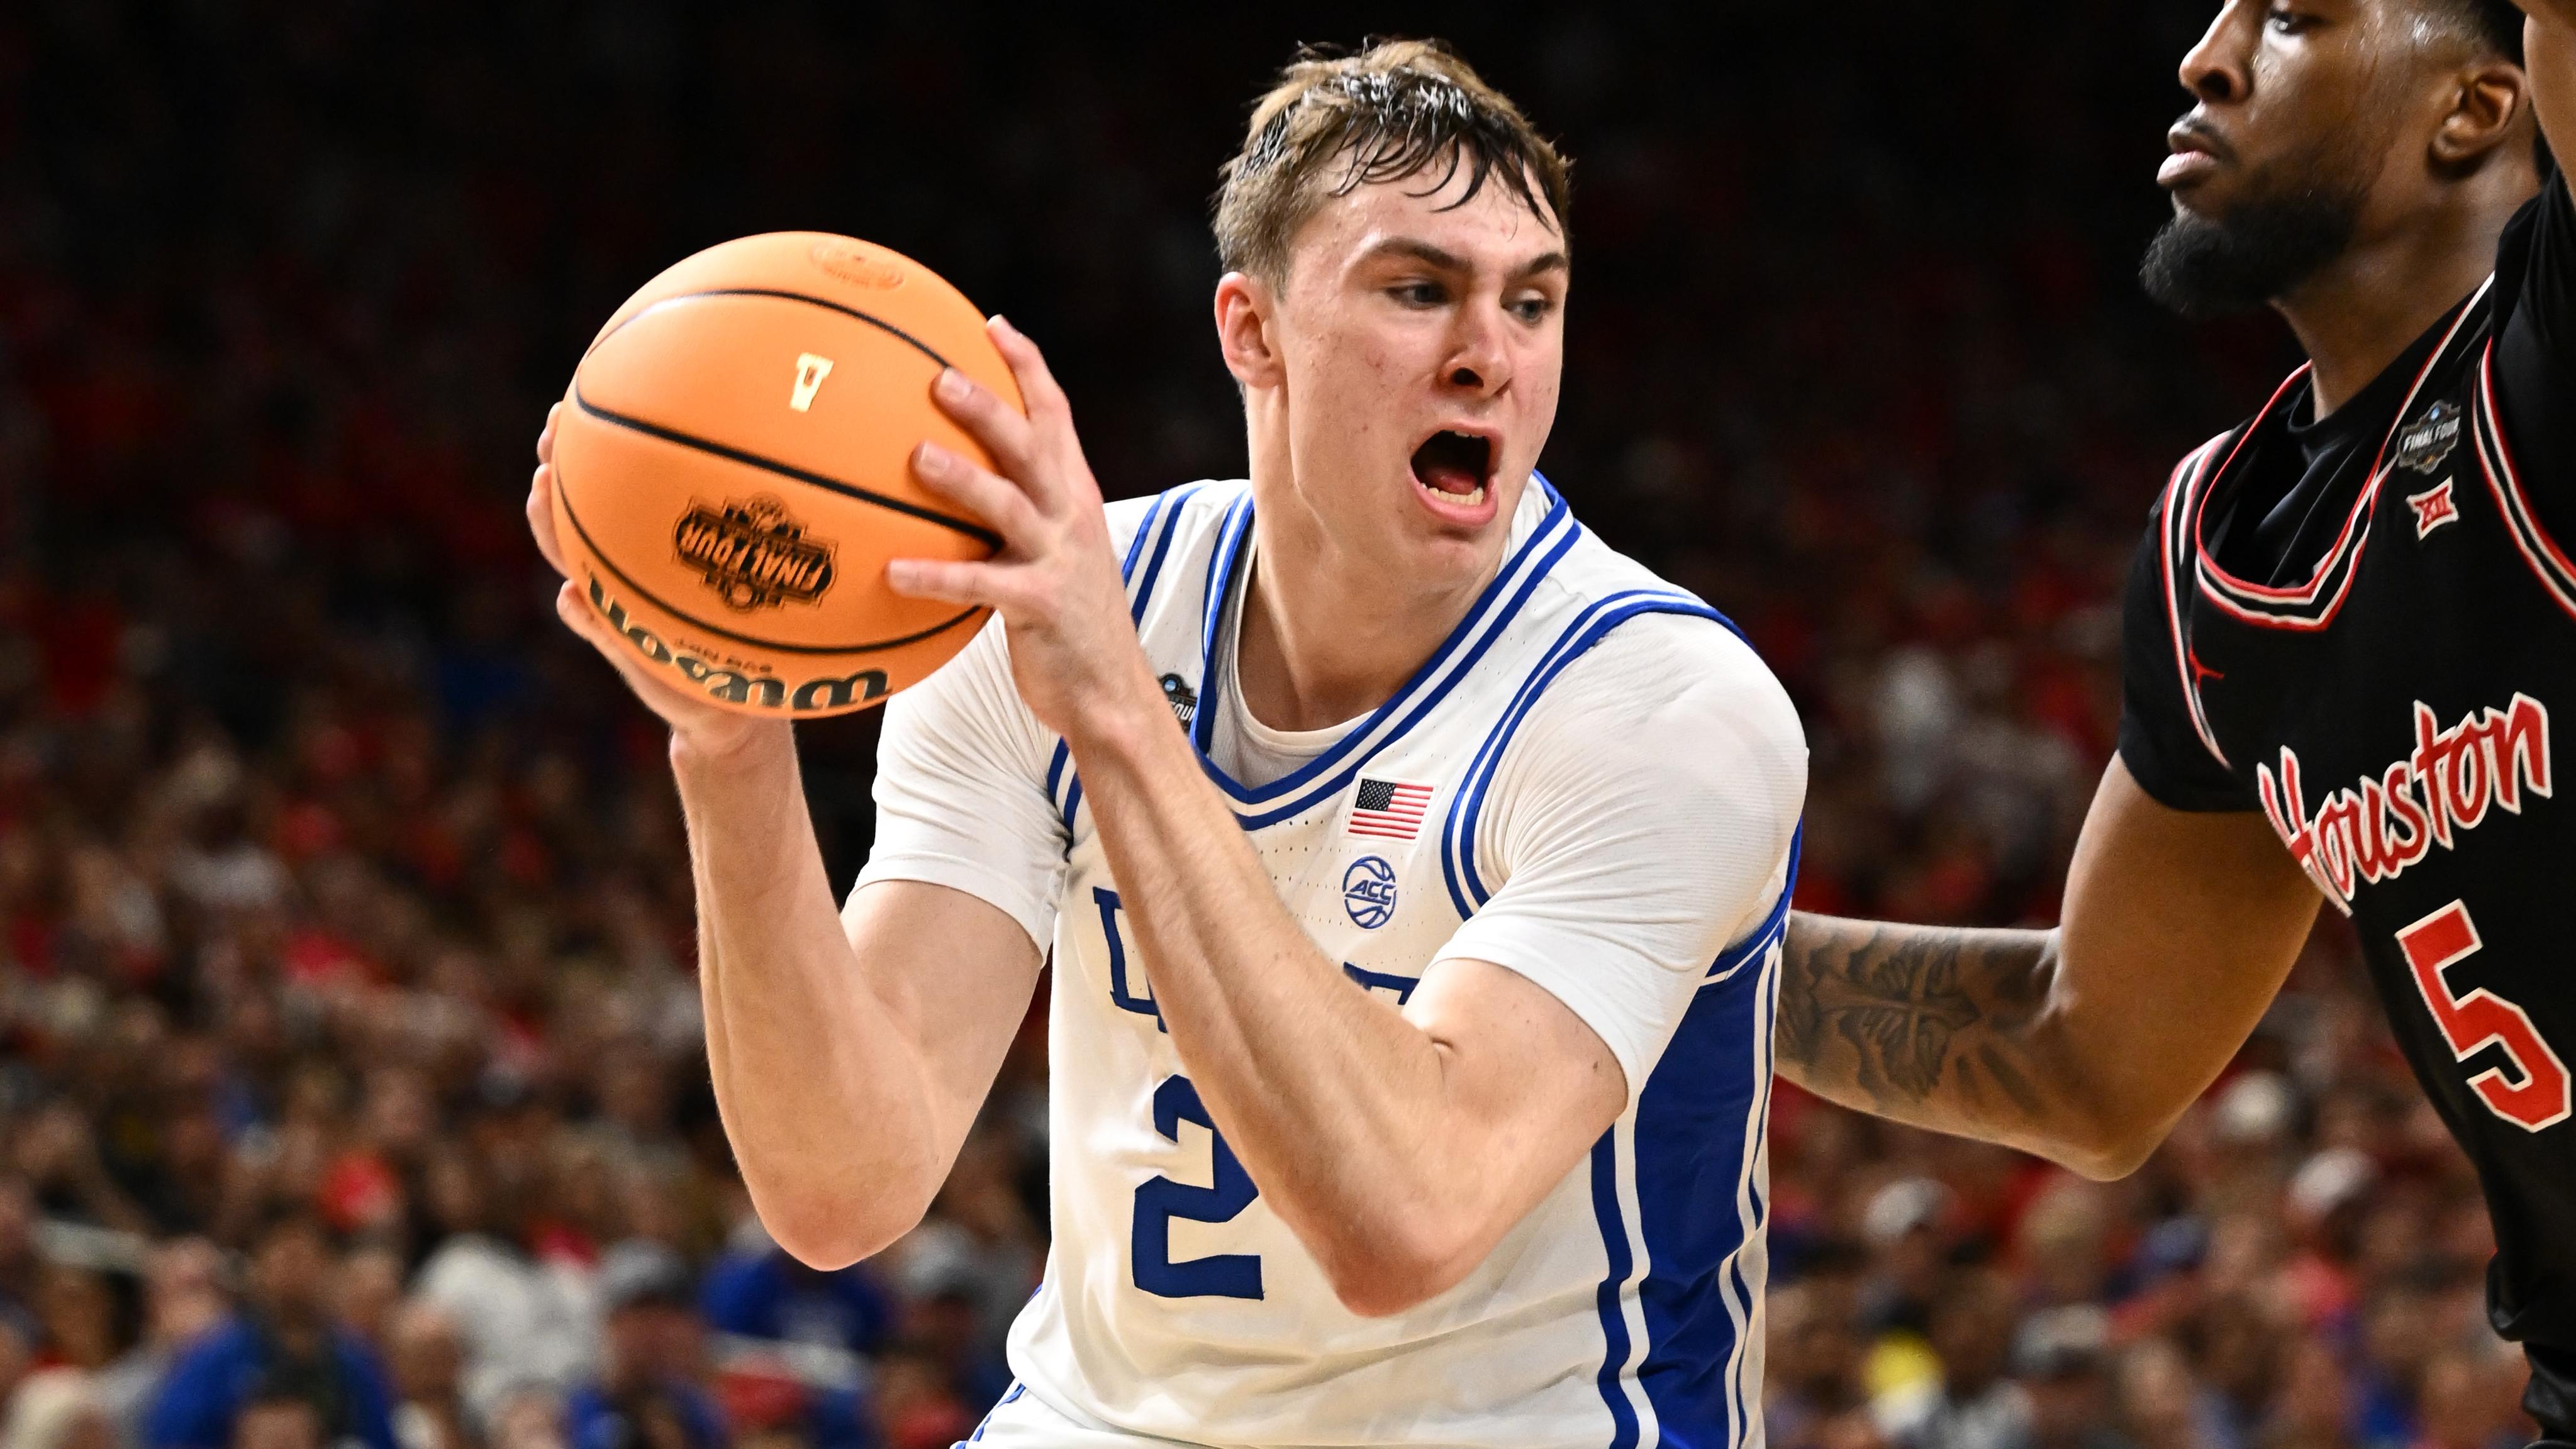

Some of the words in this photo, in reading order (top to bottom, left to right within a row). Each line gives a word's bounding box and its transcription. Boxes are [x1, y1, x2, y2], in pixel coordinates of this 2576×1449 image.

[679, 523, 752, 572] FOUR
[749, 540, 825, 590] FINAL
[1169, 701, 1197, 722] OU
[2256, 691, 2553, 918] Houston
[1349, 879, 1396, 901] ACC
[2394, 898, 2572, 1133] 5
[1132, 1074, 1264, 1301] 2
